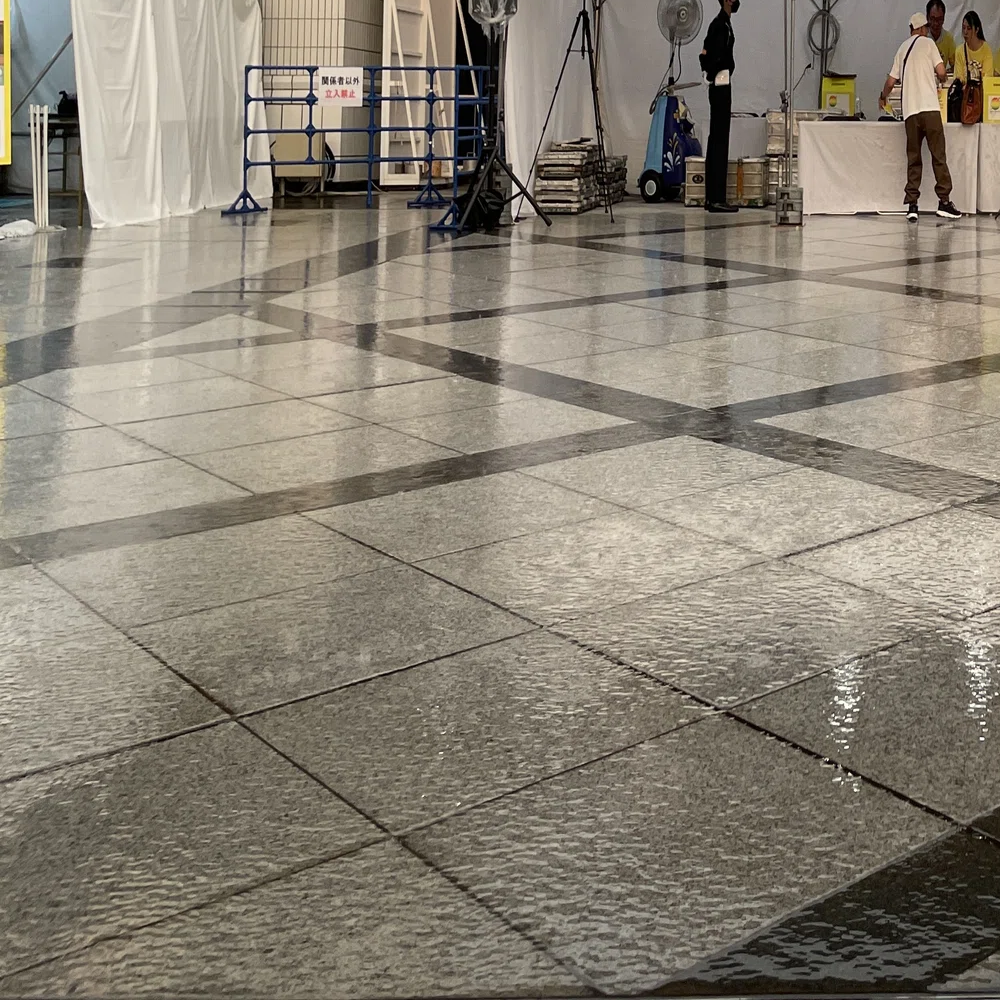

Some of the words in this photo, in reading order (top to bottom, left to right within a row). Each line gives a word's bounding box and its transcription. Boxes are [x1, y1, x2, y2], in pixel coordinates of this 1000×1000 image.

[322, 76, 359, 85] 関係者以外
[325, 89, 356, 98] 立入禁止
